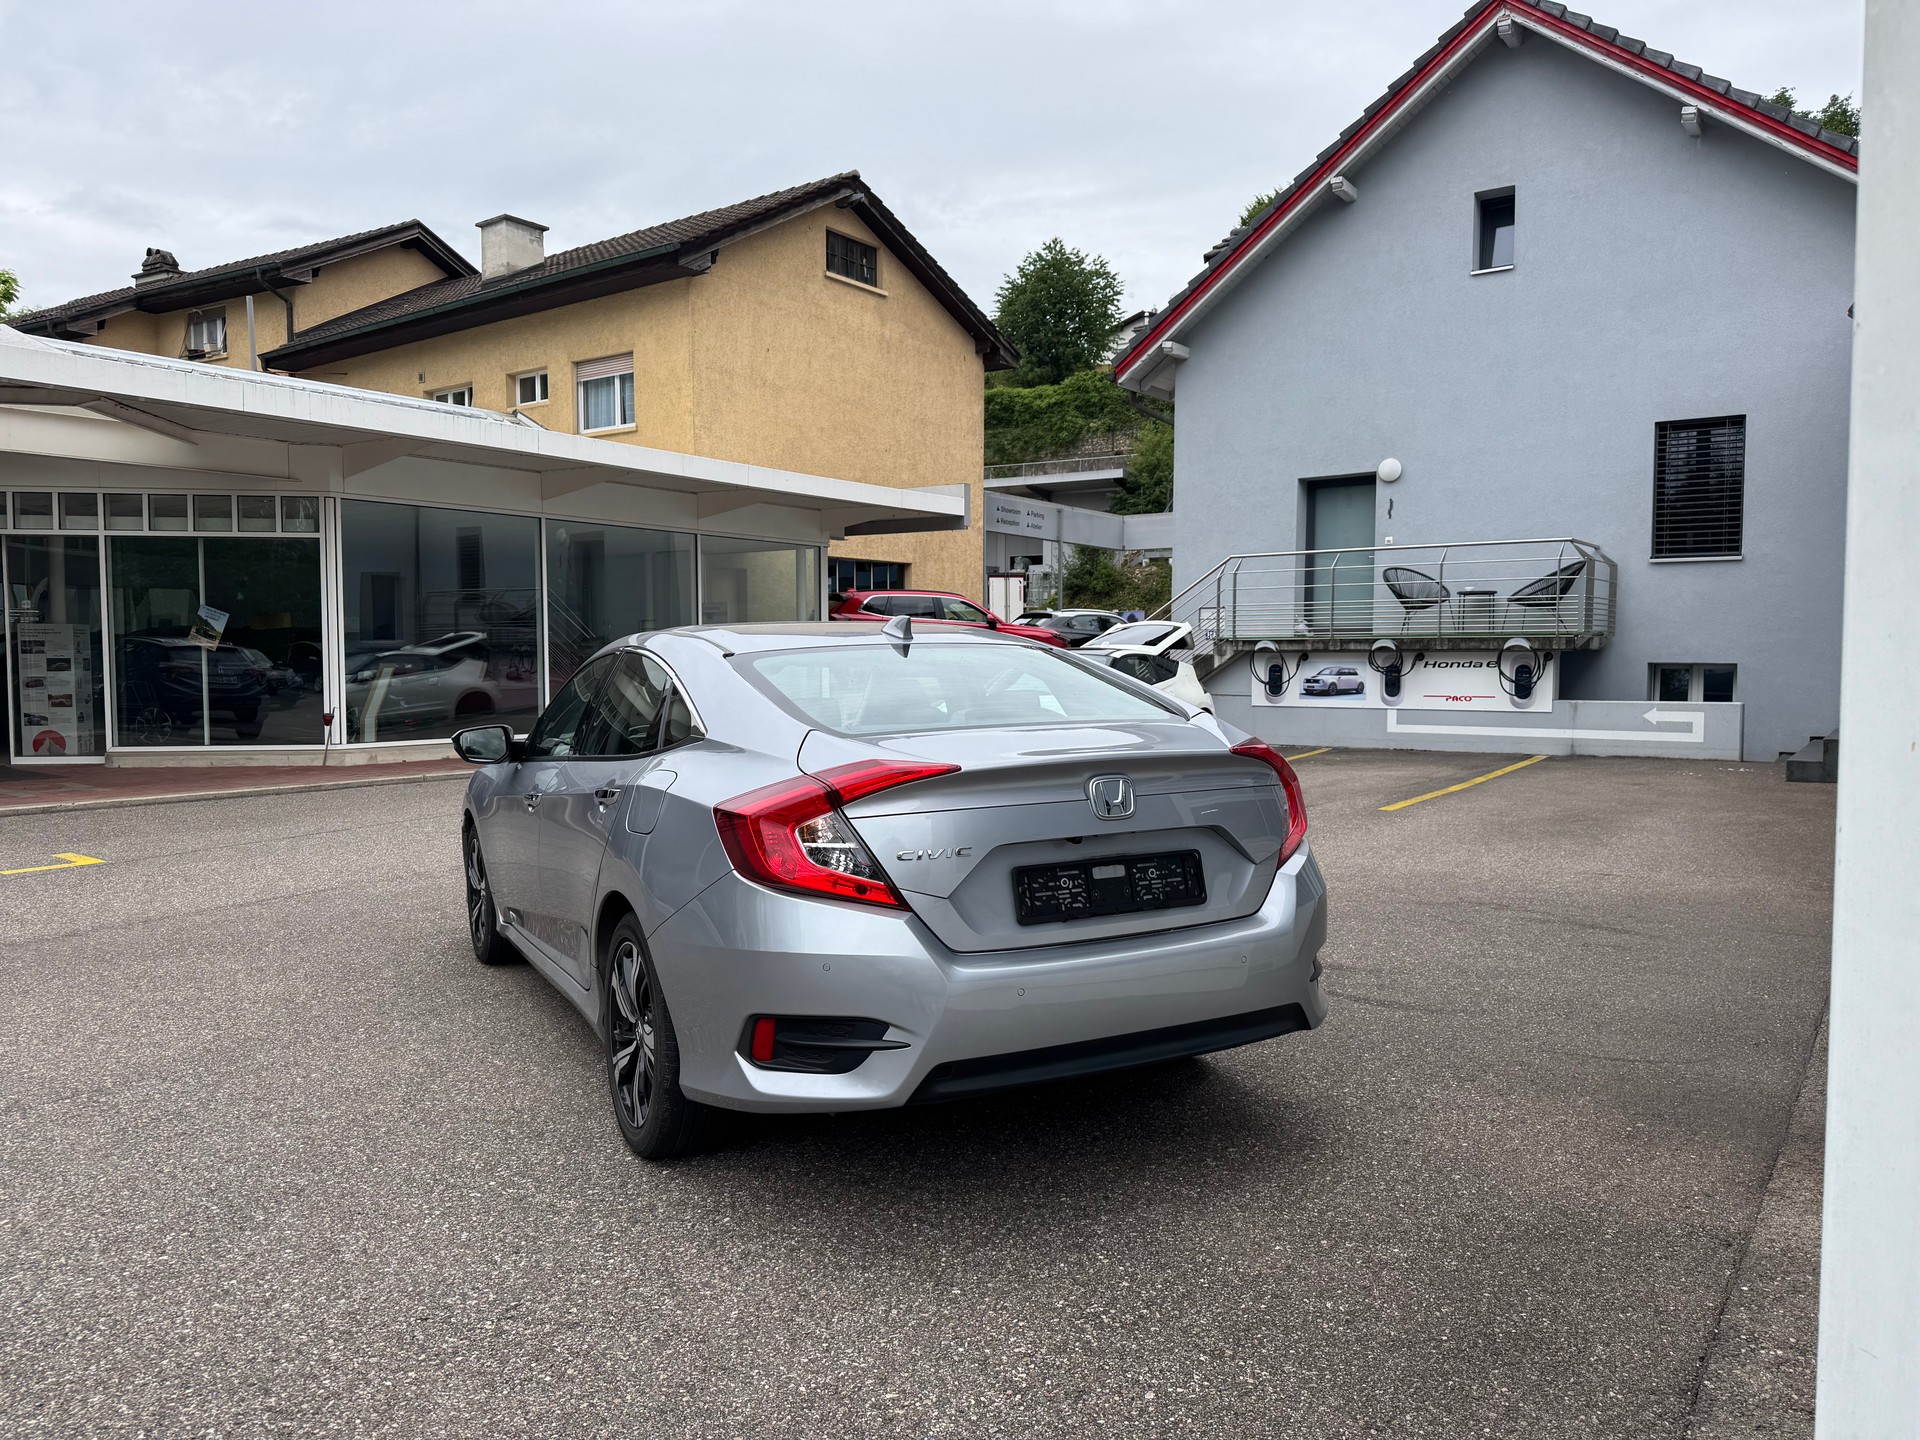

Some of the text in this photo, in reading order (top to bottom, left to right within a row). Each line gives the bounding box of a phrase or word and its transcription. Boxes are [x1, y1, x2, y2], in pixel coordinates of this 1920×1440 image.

[1000, 506, 1021, 515] Showroom
[1031, 511, 1045, 520] Parking
[1000, 517, 1020, 527] Reception
[1423, 660, 1498, 668] Honda e
[896, 846, 973, 861] CIVIC
